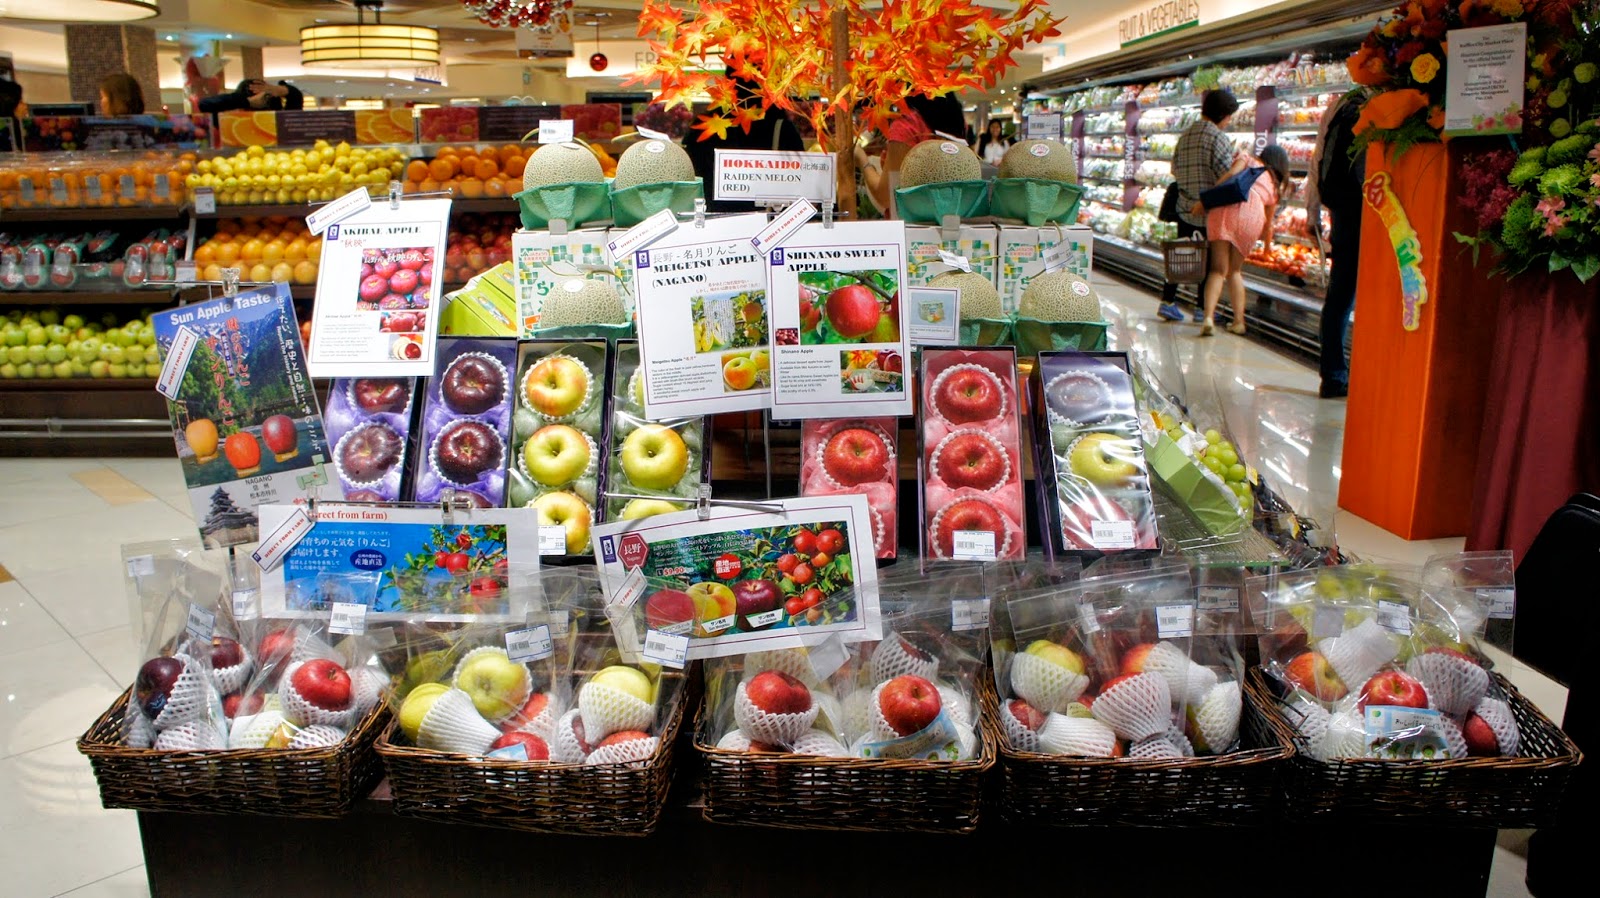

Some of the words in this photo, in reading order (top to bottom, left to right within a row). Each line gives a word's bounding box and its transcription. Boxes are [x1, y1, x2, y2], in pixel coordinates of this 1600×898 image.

[1119, 15, 1137, 40] FRUIT
[1147, 0, 1199, 32] VEGETABLES
[1124, 134, 1135, 180] JAPANESE
[723, 159, 800, 170] HOKKAIDO
[800, 162, 829, 171] (北海道)
[724, 173, 762, 181] RAIDEN
[764, 174, 802, 182] MELON
[722, 184, 750, 193] (RED)
[341, 227, 383, 236] AKIBAE
[385, 225, 422, 235] APPLE
[764, 228, 781, 243] DIRECT
[781, 217, 795, 230] FROM
[794, 206, 808, 219] FARM
[653, 251, 674, 264] 長野
[683, 243, 738, 259] 名月りんご
[787, 251, 841, 261] SHINANO
[844, 249, 887, 259] SWEET
[653, 259, 714, 274] MEIGETSU
[717, 254, 758, 268] APPLE
[787, 263, 828, 272] APPLE
[652, 272, 707, 289] (NAGANO)
[170, 312, 194, 325] Sun
[197, 303, 232, 321] Apple
[234, 293, 270, 310] Taste
[167, 366, 177, 386] DIRECT
[205, 335, 235, 427] サンりんご
[245, 475, 273, 485] NAGANO
[338, 510, 359, 520] from
[361, 510, 388, 521] farm)
[264, 542, 280, 558] DIRECT
[624, 542, 642, 556] 長野
[354, 557, 384, 567] 産地直送
